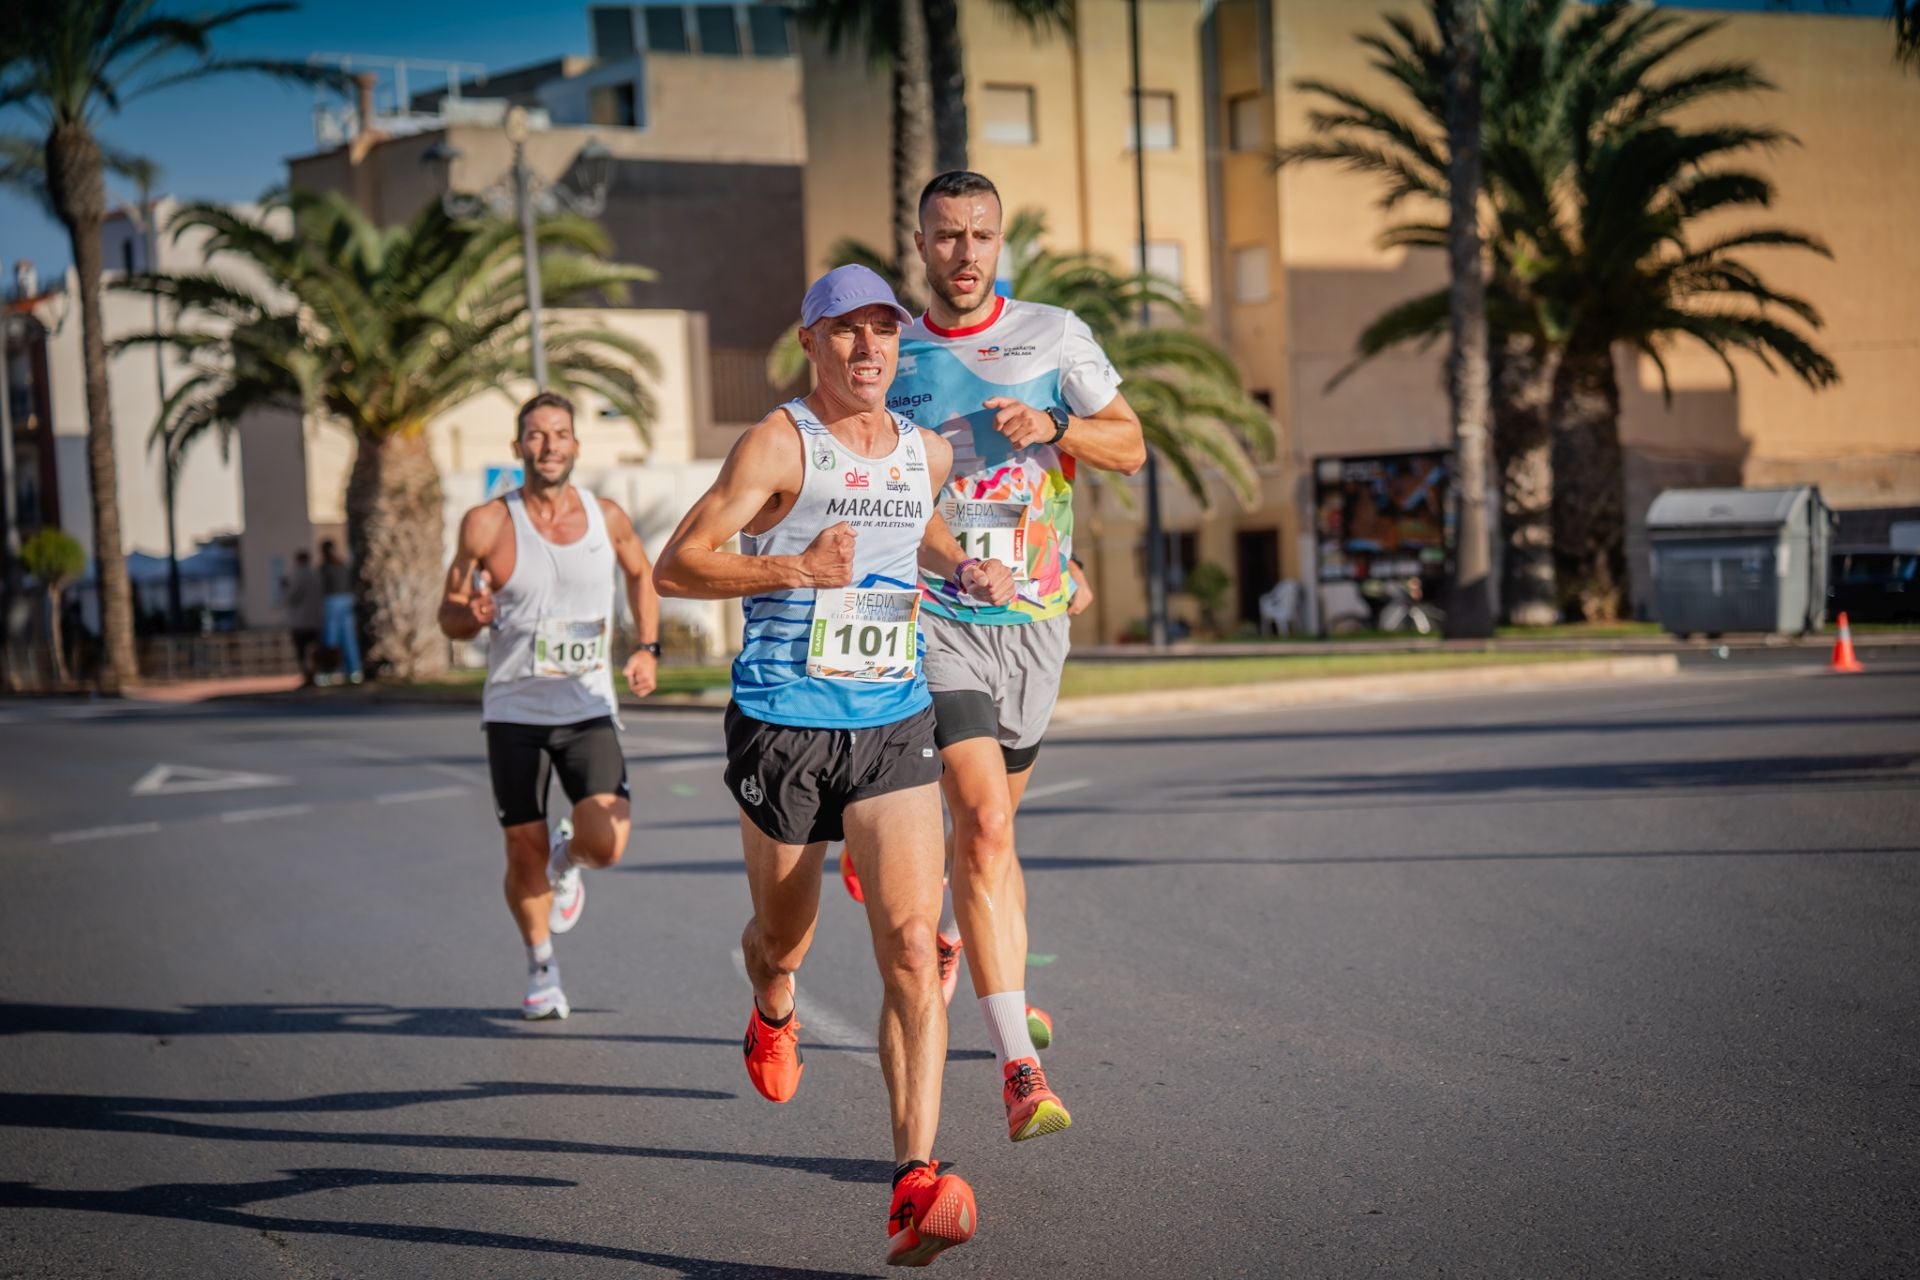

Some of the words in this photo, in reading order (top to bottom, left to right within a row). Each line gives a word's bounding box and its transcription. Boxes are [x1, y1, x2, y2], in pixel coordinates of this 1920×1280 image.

[826, 498, 922, 518] MARACENA
[957, 503, 993, 516] MEDIA
[856, 593, 895, 609] MEDIA
[835, 624, 898, 657] 101
